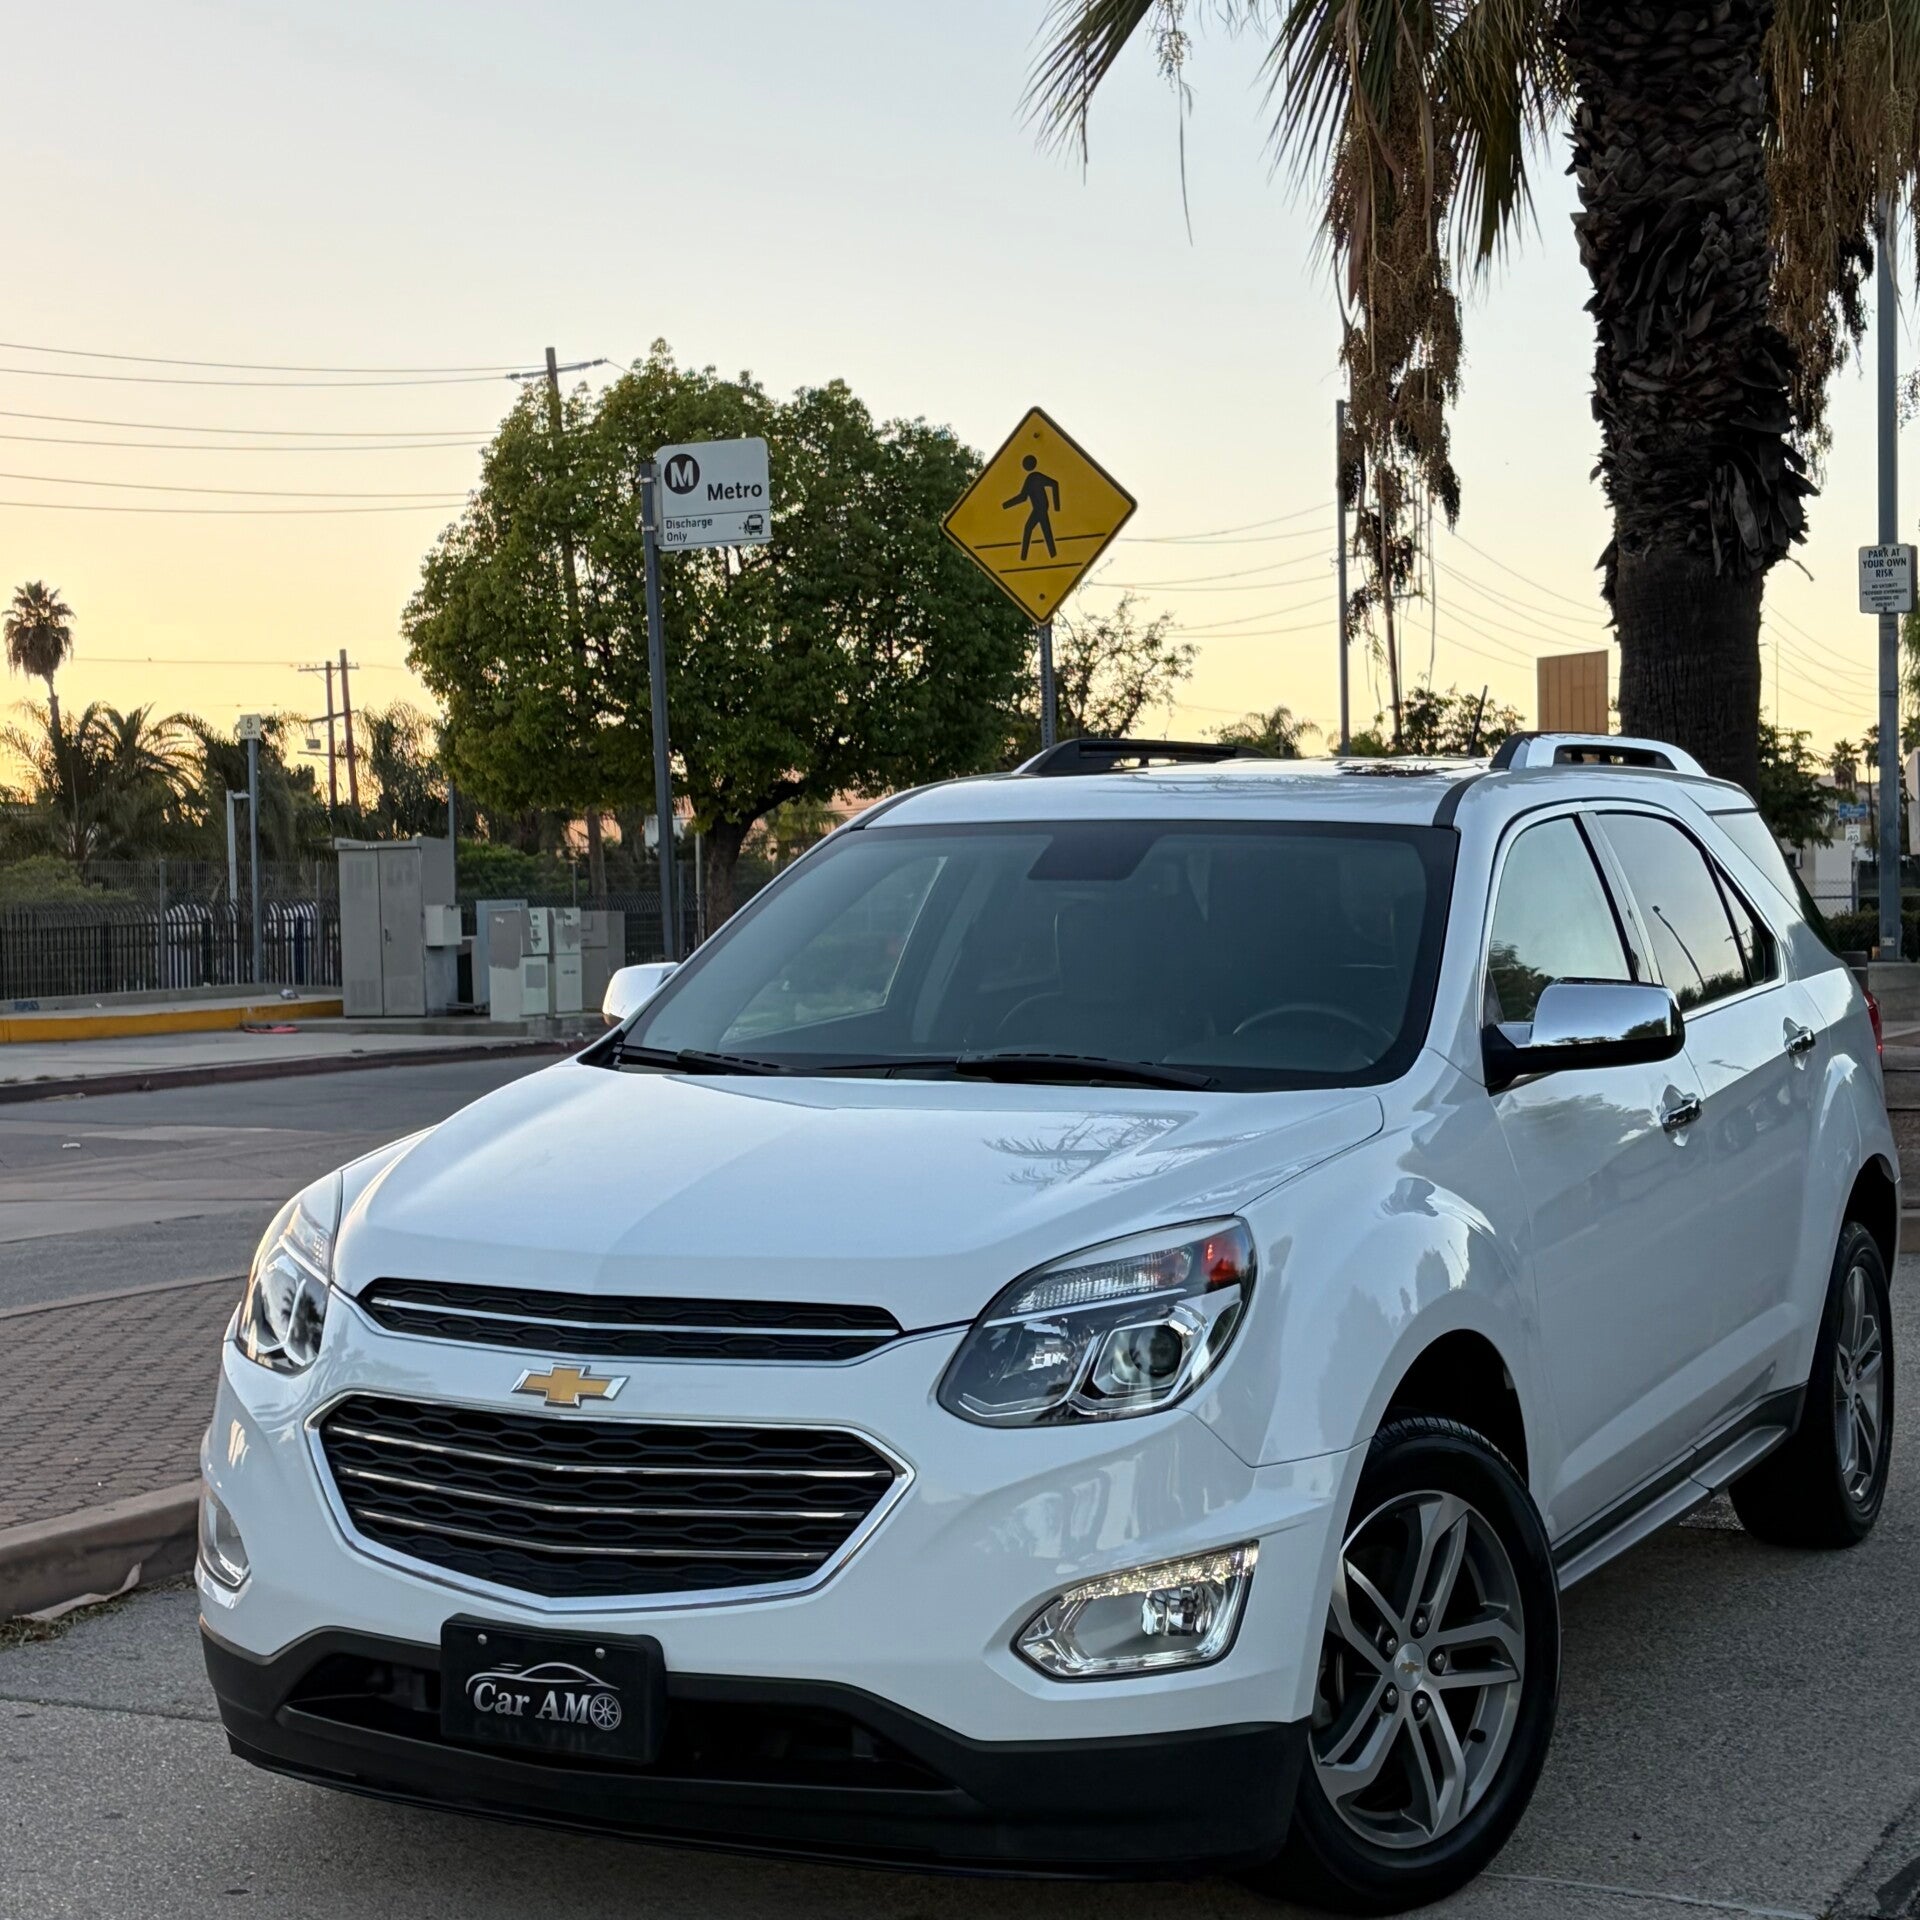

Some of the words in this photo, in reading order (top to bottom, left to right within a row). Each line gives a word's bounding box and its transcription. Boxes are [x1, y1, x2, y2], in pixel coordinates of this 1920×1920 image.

[707, 482, 763, 501] Metro
[666, 518, 713, 530] Discharge
[666, 531, 688, 542] Only
[1868, 548, 1889, 559] PARK
[1891, 548, 1900, 557] AT
[1862, 560, 1884, 569] YOUR
[1886, 558, 1907, 567] OWN
[1875, 569, 1894, 578] RISK
[246, 717, 253, 729] 5
[473, 1682, 530, 1716] Car
